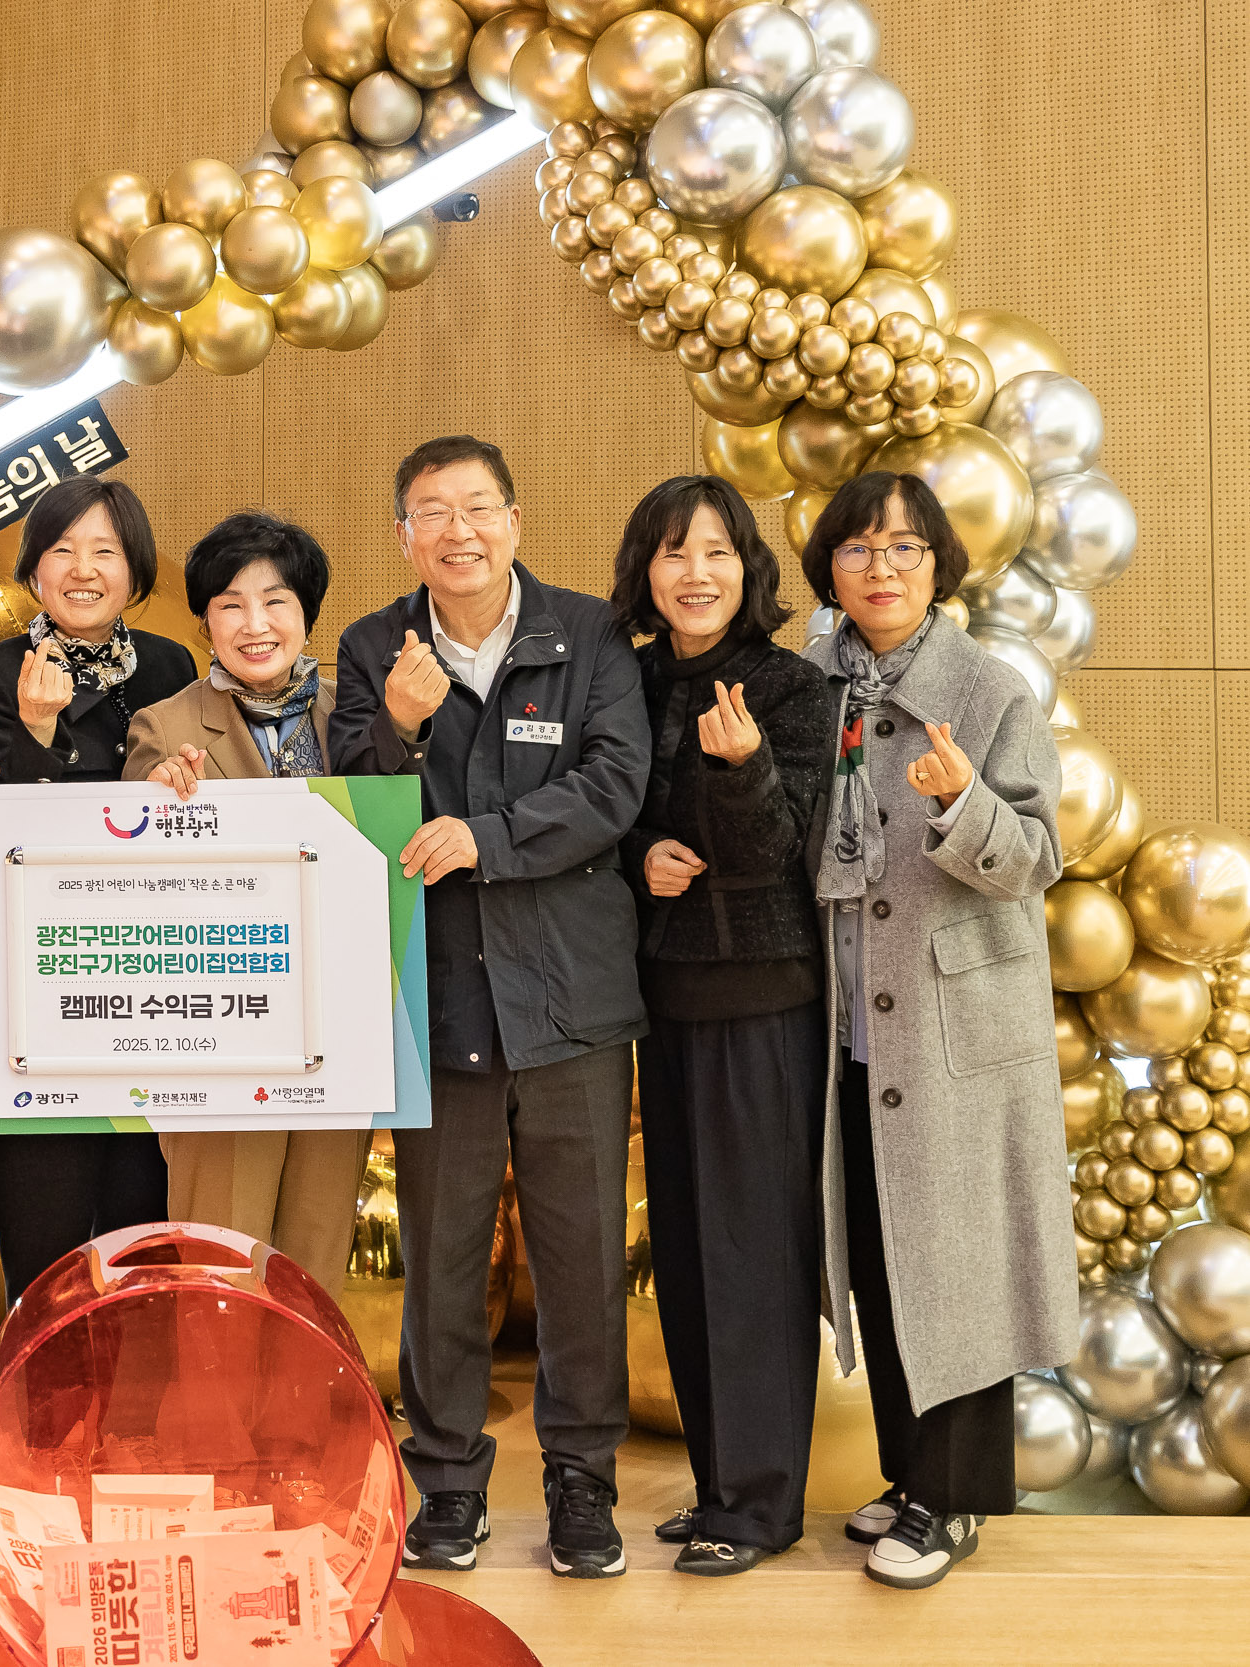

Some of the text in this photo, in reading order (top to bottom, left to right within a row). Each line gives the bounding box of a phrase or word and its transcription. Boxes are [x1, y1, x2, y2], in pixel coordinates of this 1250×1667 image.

[54, 416, 112, 473] 날
[155, 804, 217, 817] 소통하며 발전하는
[155, 816, 218, 838] 행복광진
[58, 880, 83, 890] 2025
[85, 879, 105, 892] 광진
[106, 879, 135, 892] 어린이
[211, 878, 223, 891] 손,
[225, 878, 234, 891] 큰
[36, 924, 290, 947] 광진구민간어린이집연합회
[36, 952, 290, 975] 광진구가정어린이집연합회
[60, 993, 270, 1019] 캠페인 수익금 기부
[113, 1038, 152, 1052] 2025.
[155, 1038, 172, 1052] 12.
[35, 1092, 80, 1105] 광진구
[152, 1092, 207, 1103] 광진복지재단
[271, 1088, 325, 1099] 사랑의열매
[107, 1559, 140, 1665] 따뜻한
[139, 1559, 165, 1663] 겨울나기
[94, 1627, 108, 1665] 2026
